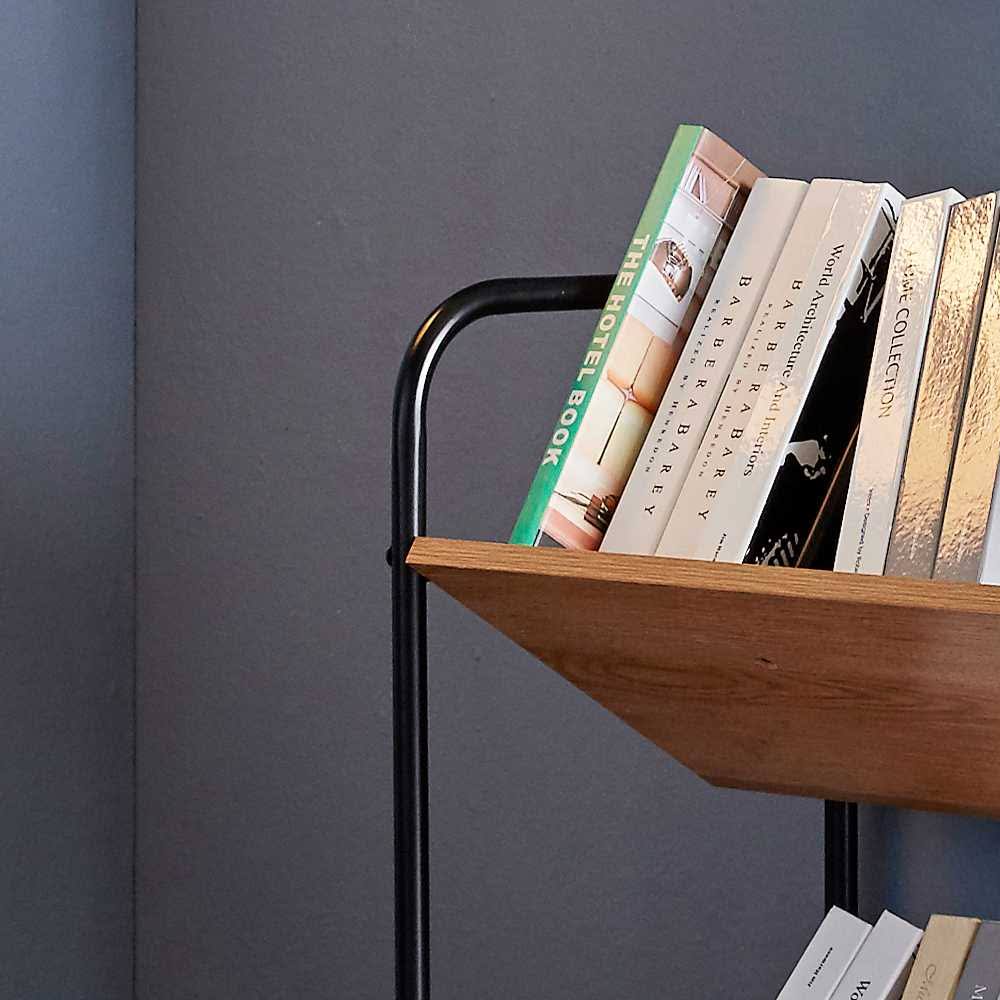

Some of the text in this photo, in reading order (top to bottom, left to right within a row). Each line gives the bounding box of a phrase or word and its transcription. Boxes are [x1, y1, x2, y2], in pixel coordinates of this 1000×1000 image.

[541, 234, 650, 467] THE HOTEL BOOK
[644, 275, 752, 516] BARBERA BAREY
[743, 243, 845, 478] World Architecture And Interiors
[878, 307, 910, 419] COLLECTION
[698, 428, 744, 521] BAREY
